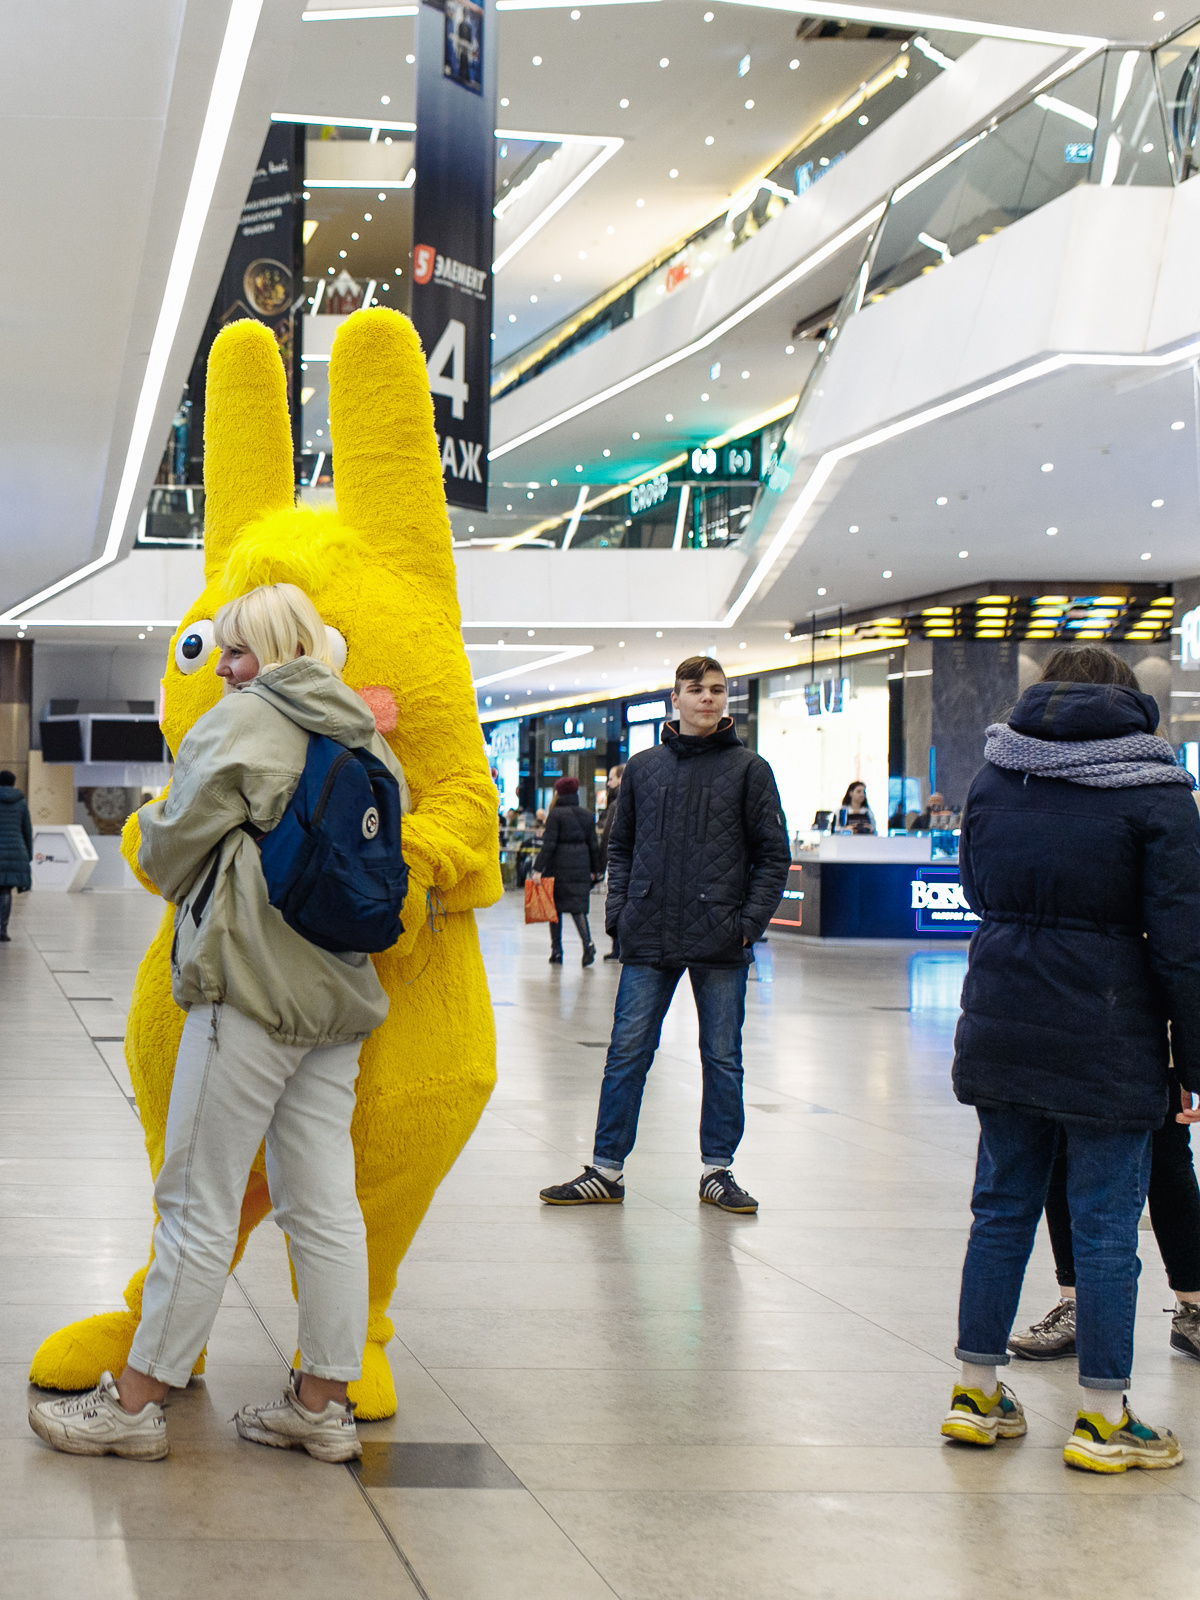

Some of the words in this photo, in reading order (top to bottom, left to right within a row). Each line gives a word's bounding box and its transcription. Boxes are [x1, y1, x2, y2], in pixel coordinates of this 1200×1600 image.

[415, 250, 429, 277] 5
[434, 254, 487, 292] ЭЛЕМЕНТ
[427, 319, 469, 420] 4
[436, 434, 483, 483] АЖ
[83, 1410, 98, 1420] FILA
